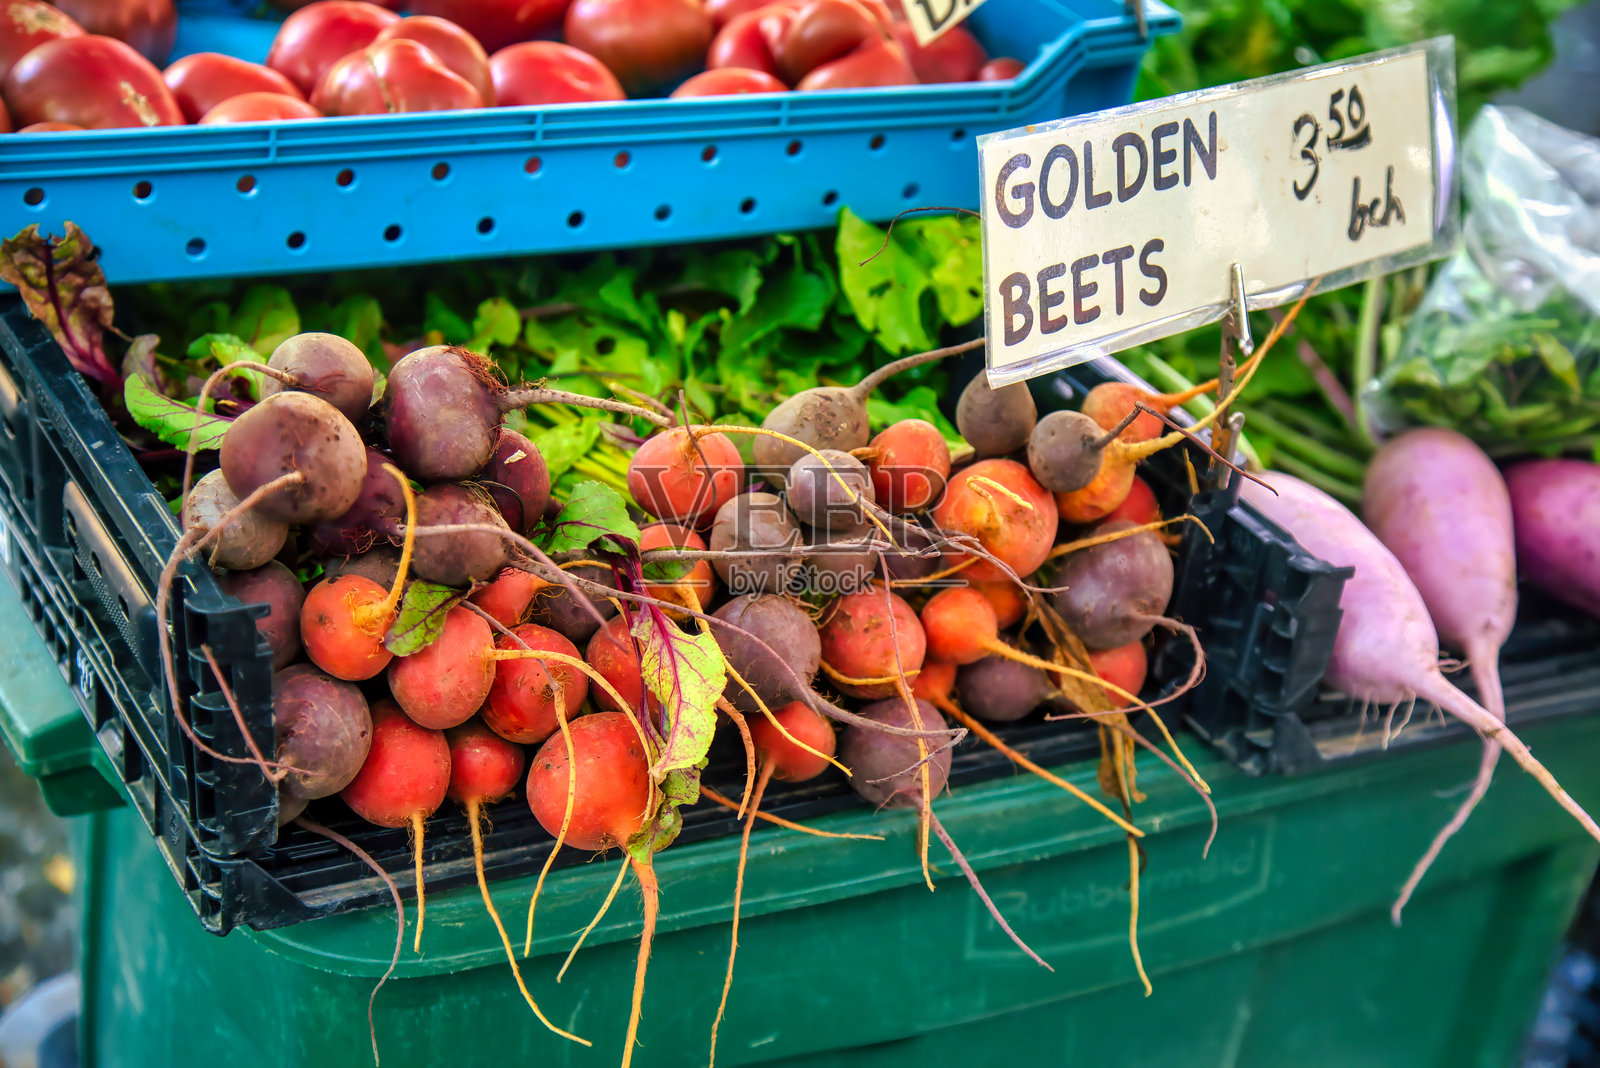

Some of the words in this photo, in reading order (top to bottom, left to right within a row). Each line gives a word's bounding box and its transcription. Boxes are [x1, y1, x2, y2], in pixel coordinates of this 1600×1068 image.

[995, 111, 1218, 229] GOLDEN
[1347, 165, 1406, 242] bch
[999, 238, 1168, 347] BEETS
